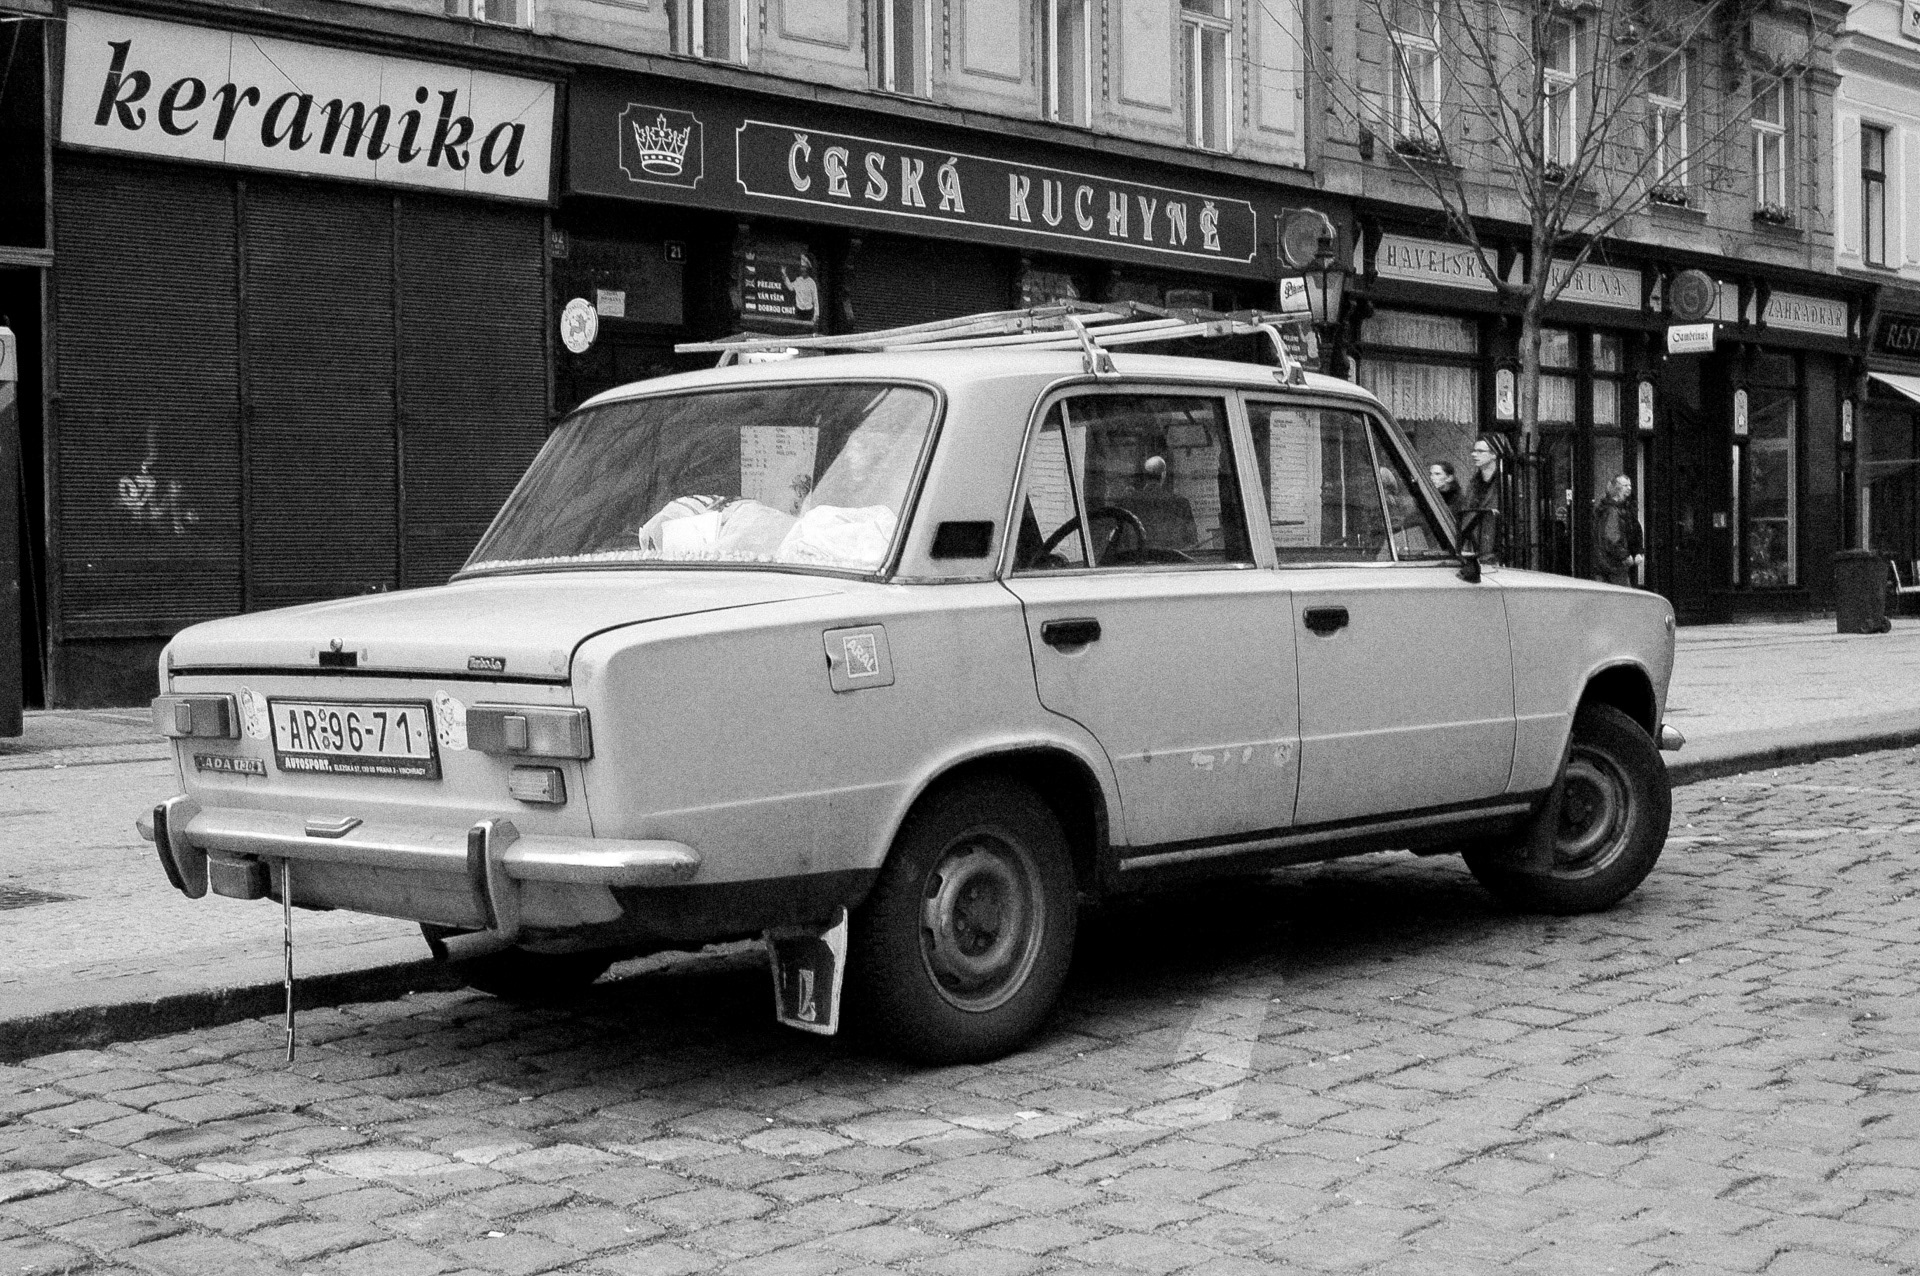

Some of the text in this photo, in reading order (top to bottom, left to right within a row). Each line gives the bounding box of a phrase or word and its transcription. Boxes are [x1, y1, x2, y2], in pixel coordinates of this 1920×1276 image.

[94, 39, 526, 178] keramika
[788, 132, 1221, 252] ČESKÁ KUCHYNĚ
[670, 246, 681, 258] 21
[847, 640, 874, 672] ARAL
[200, 757, 232, 771] ADA
